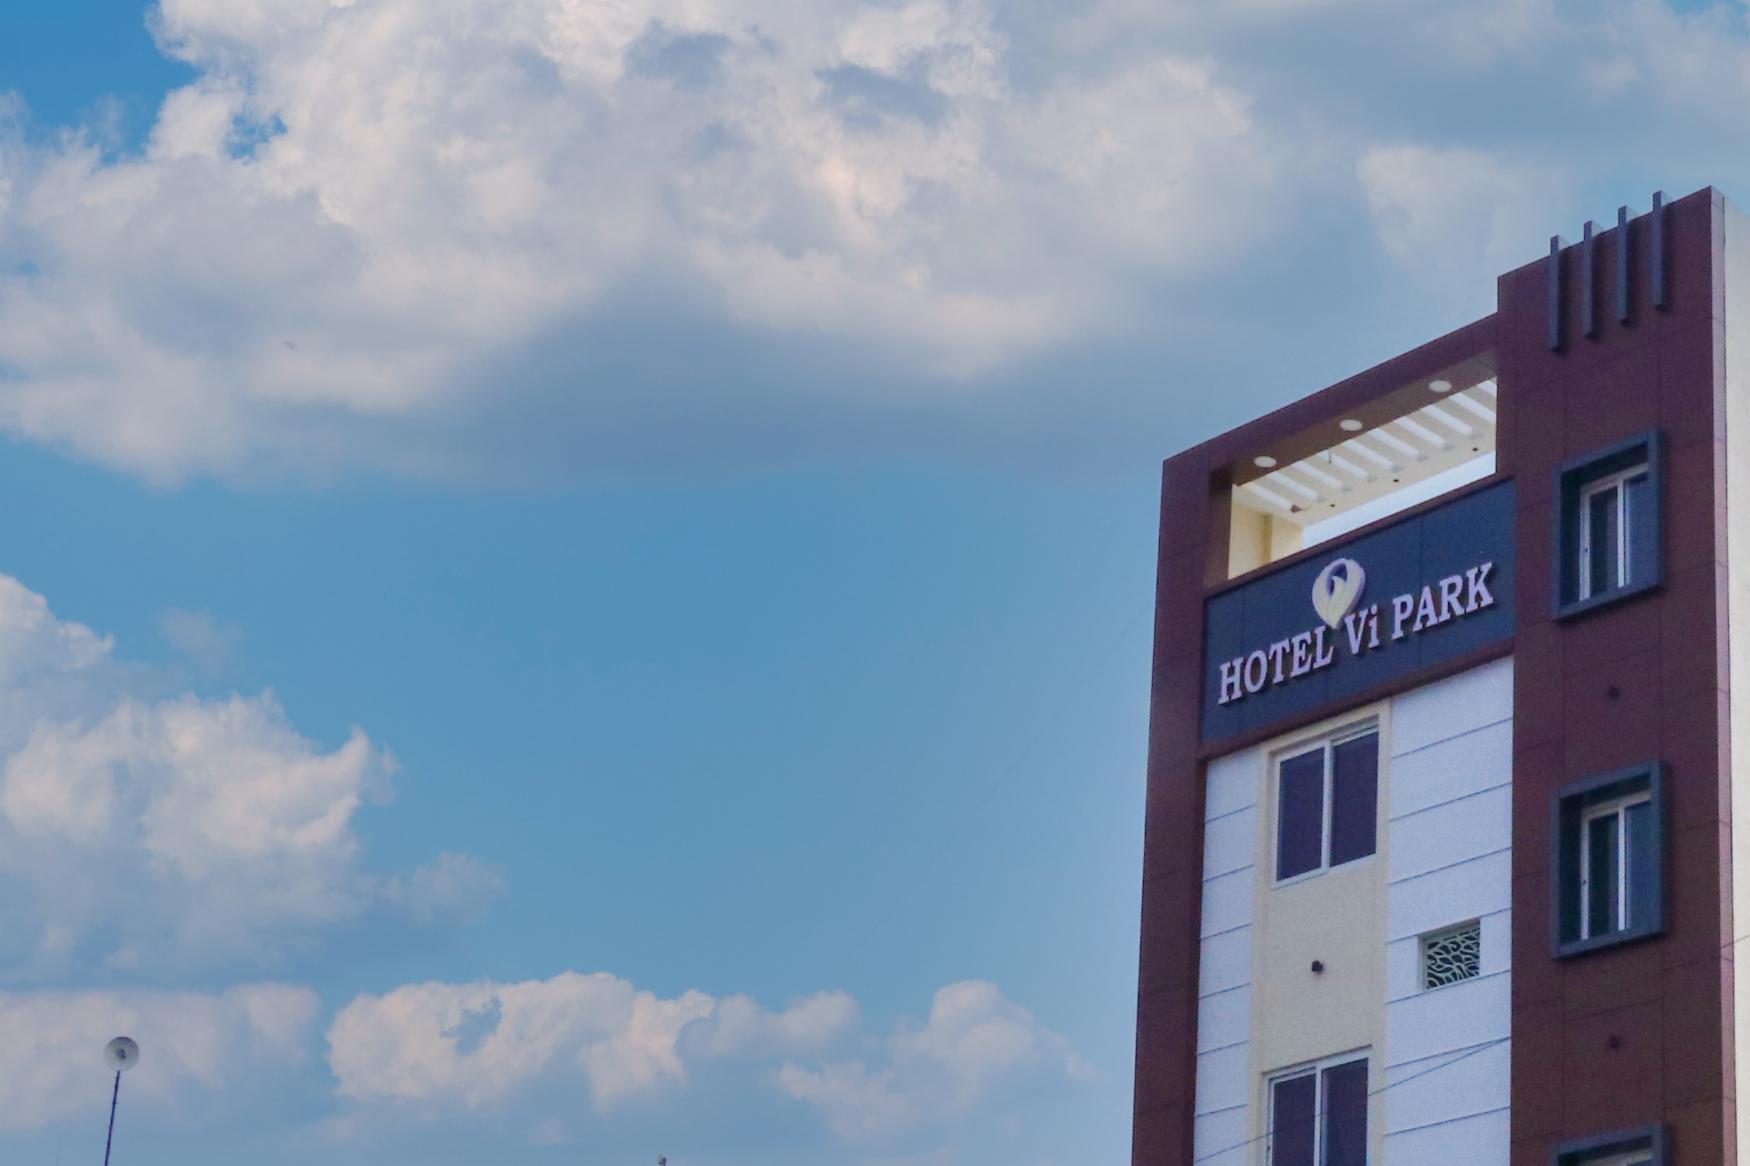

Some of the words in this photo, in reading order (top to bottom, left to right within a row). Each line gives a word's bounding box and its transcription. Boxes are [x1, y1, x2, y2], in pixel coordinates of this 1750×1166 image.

[1217, 625, 1334, 706] HOTEL
[1344, 605, 1380, 656] Vi
[1391, 561, 1496, 641] PARK
